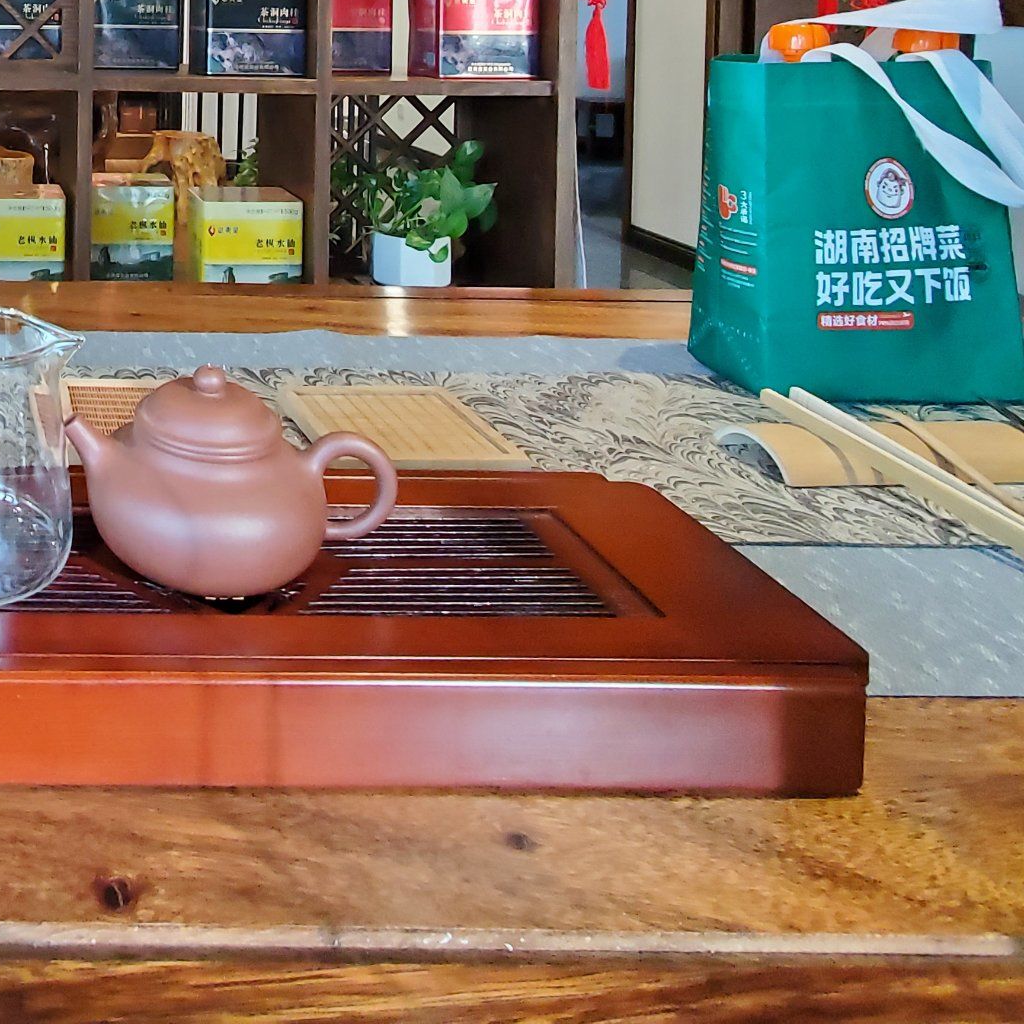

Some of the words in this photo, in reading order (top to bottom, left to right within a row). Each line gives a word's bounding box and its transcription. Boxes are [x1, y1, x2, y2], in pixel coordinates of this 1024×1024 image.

[814, 225, 967, 265] 湖南招牌菜
[816, 266, 972, 307] 好吃又下饭
[820, 315, 879, 327] 精选好食材
